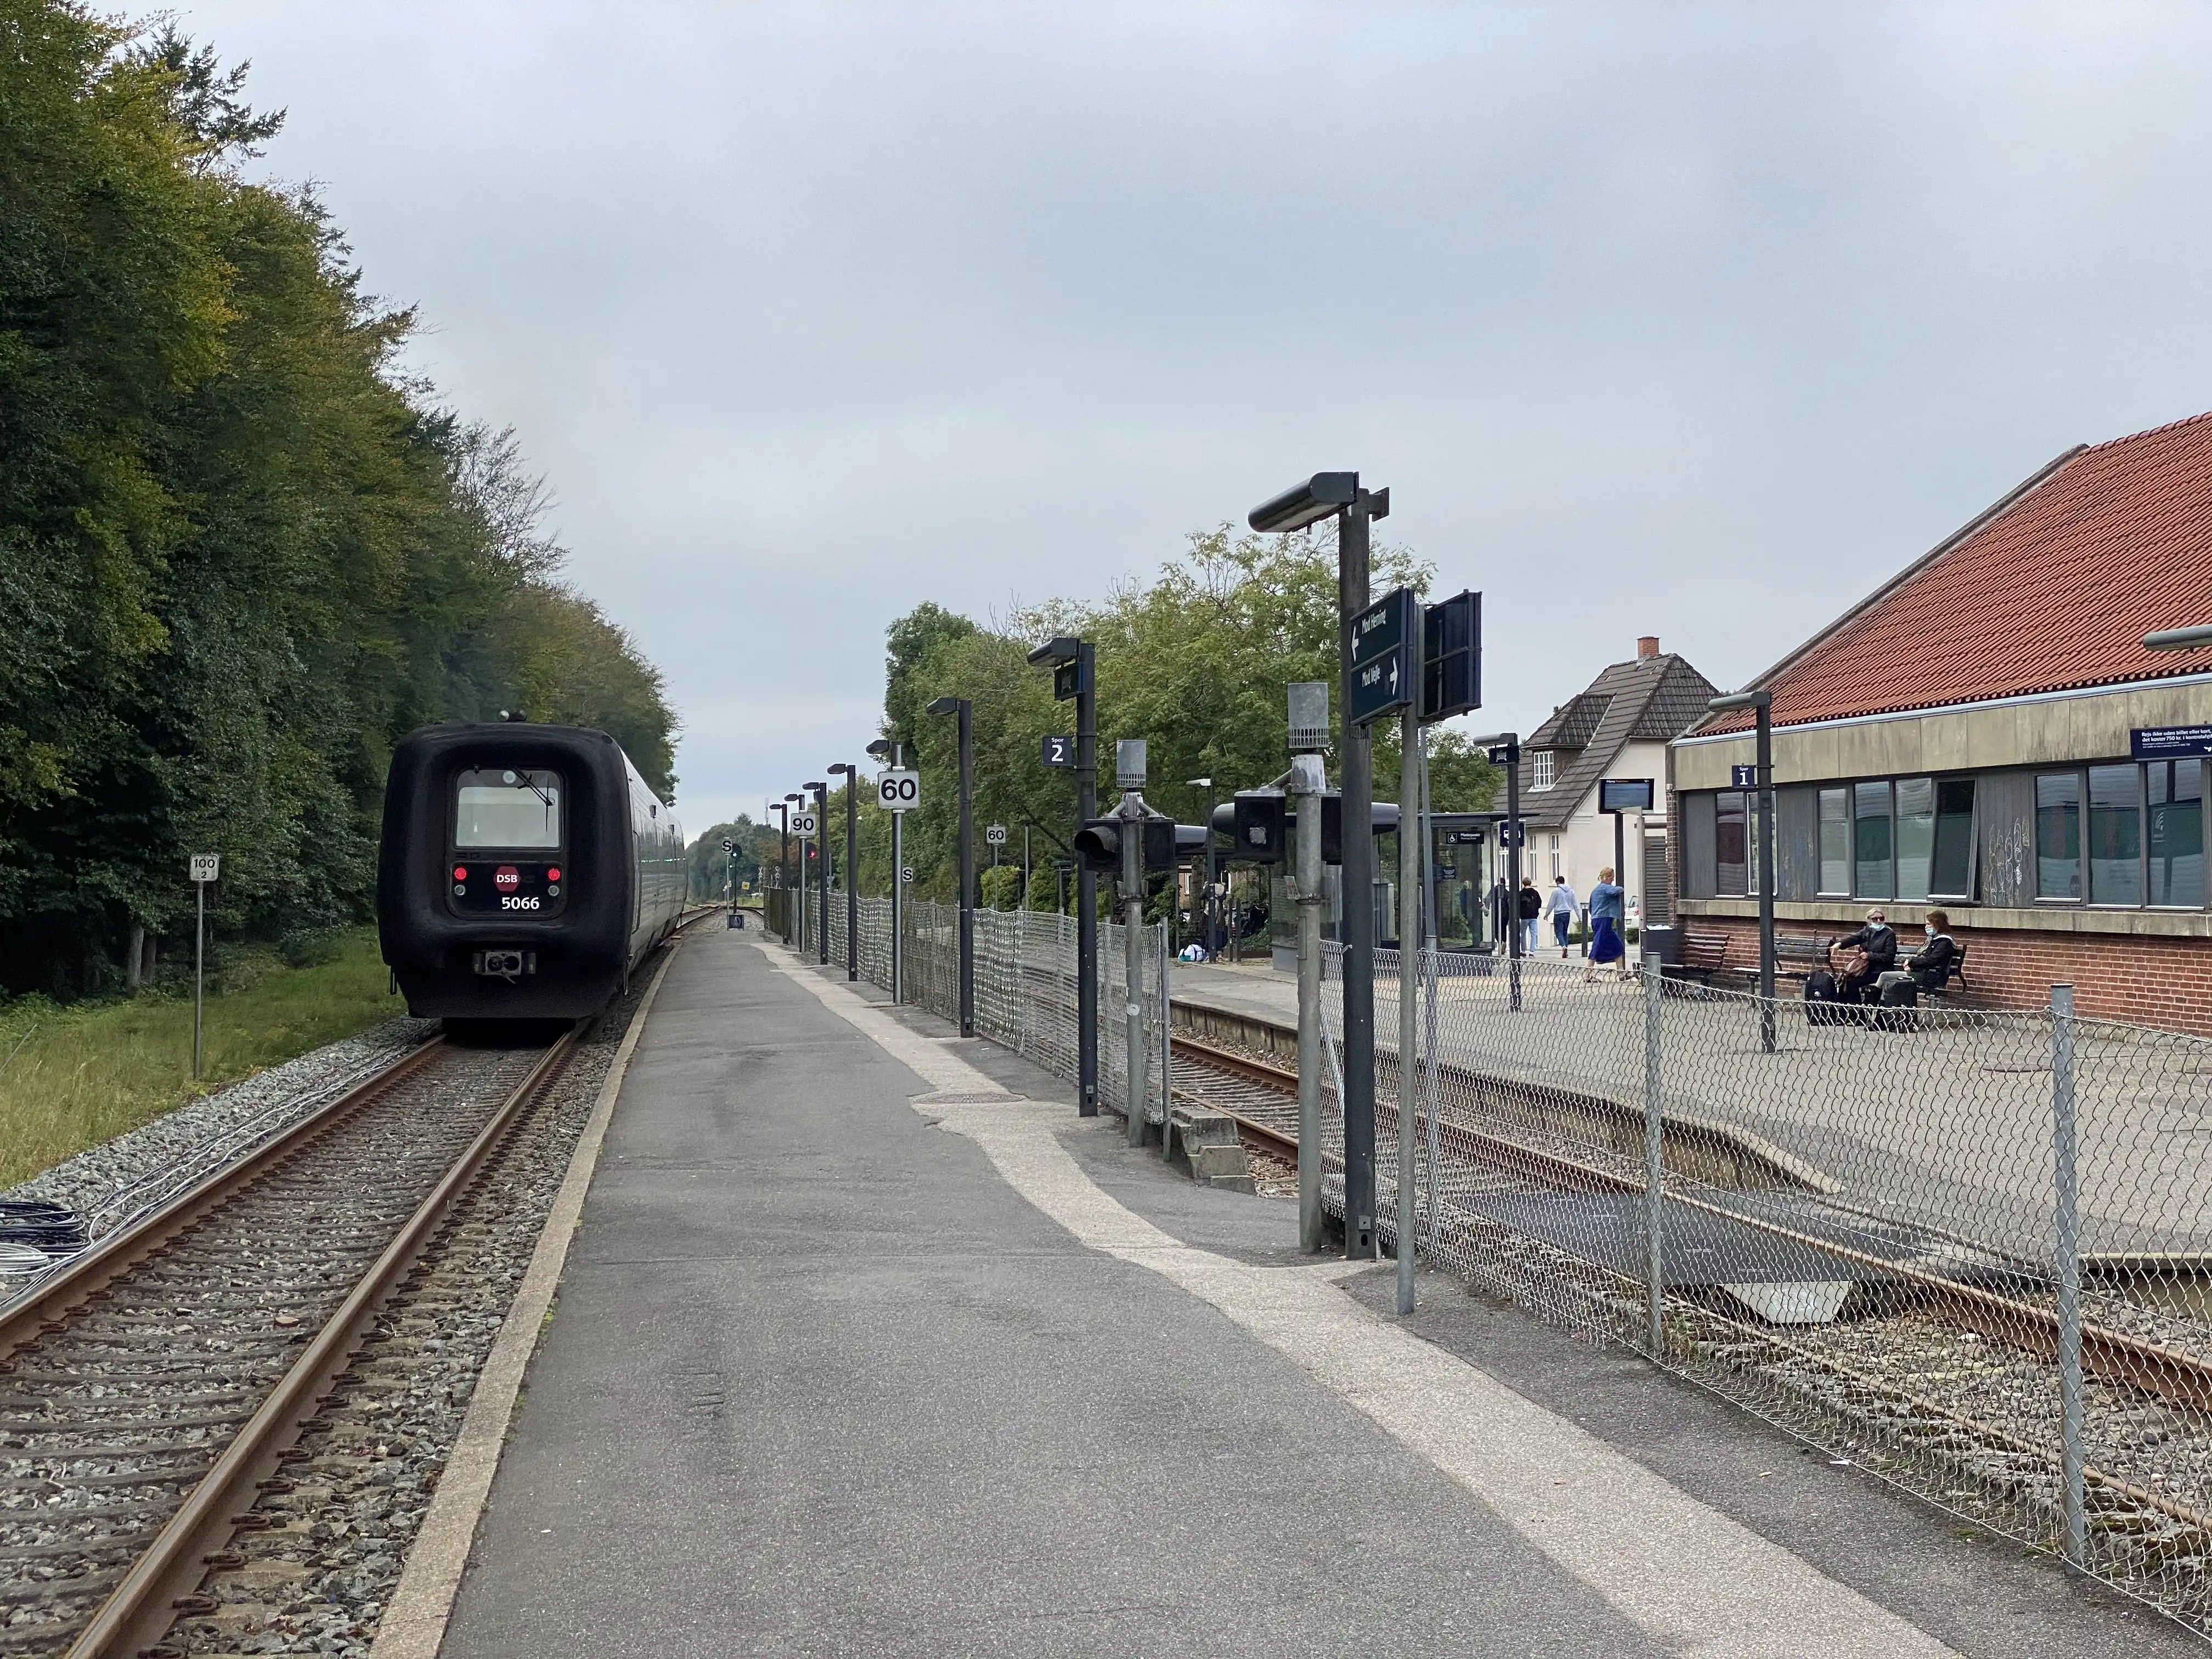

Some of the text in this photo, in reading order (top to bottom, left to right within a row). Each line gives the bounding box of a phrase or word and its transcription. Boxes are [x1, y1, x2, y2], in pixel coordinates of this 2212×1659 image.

[1051, 744, 1063, 762] 2
[1740, 772, 1748, 785] 1
[881, 778, 916, 800] 60
[793, 817, 814, 831] 90
[988, 830, 1004, 840] 60
[722, 840, 732, 852] S
[194, 858, 216, 868] 100
[496, 874, 518, 883] DSB
[902, 869, 912, 881] S
[501, 896, 540, 910] 5066
